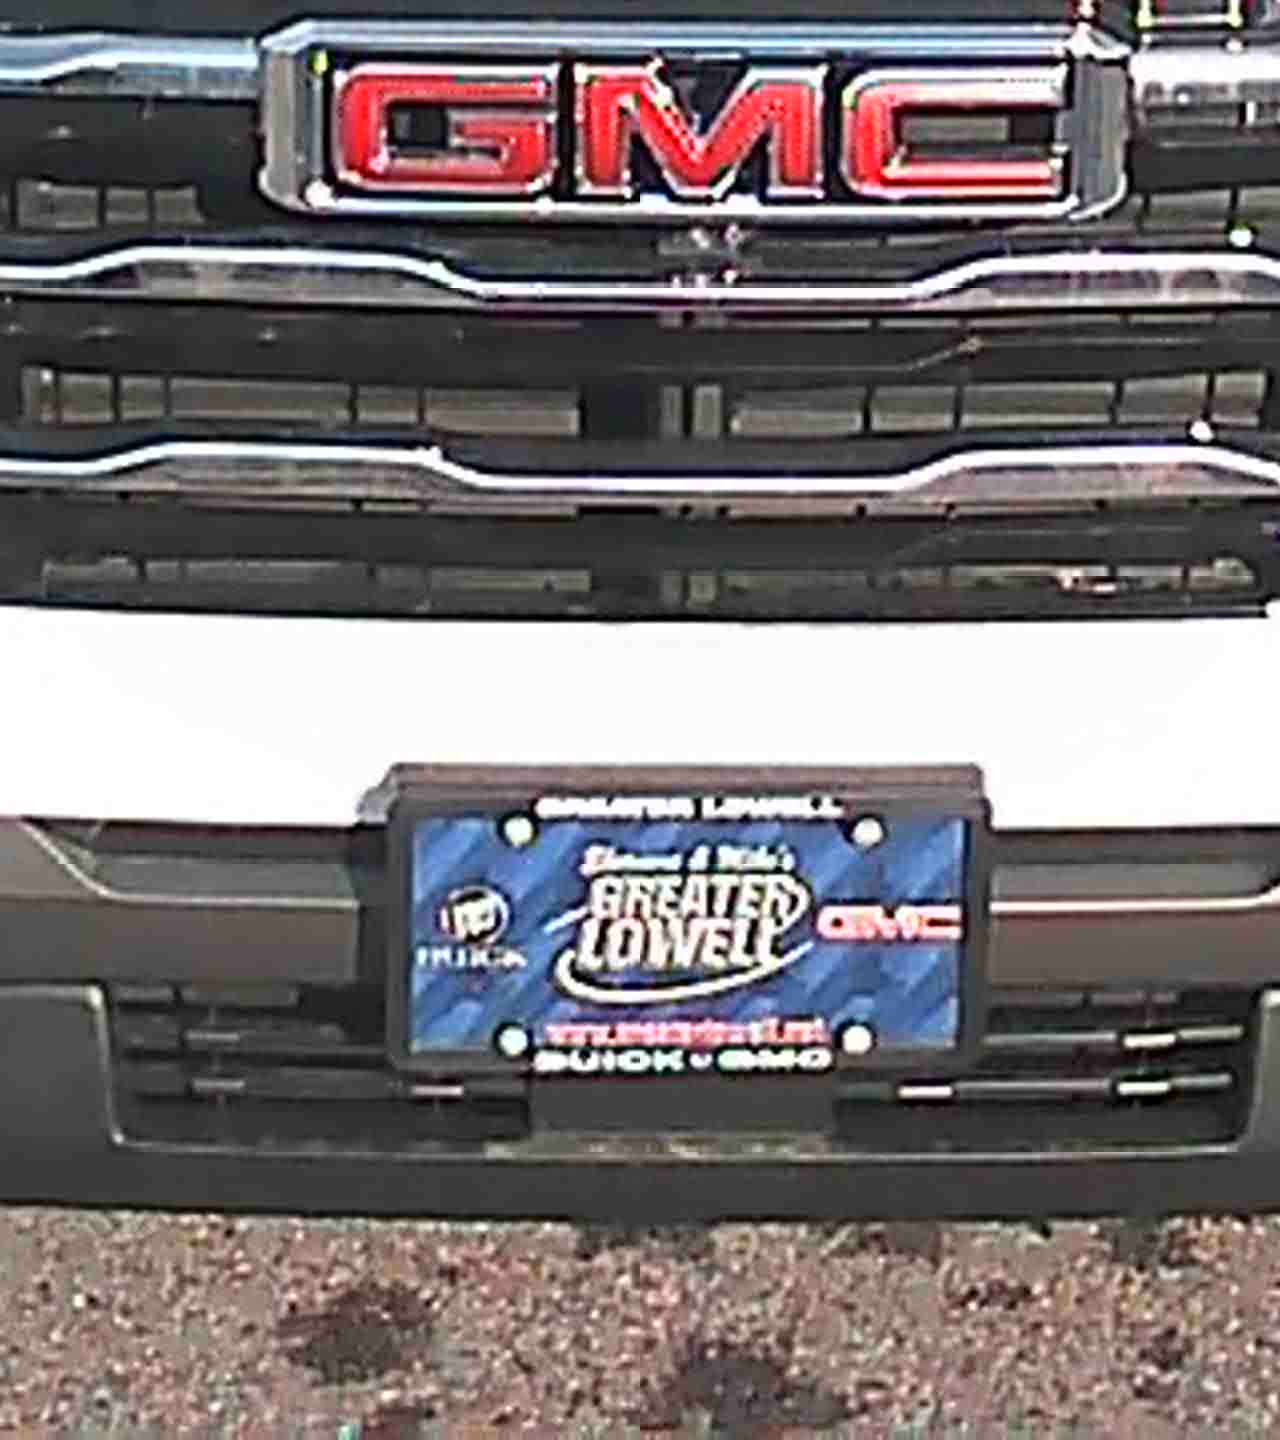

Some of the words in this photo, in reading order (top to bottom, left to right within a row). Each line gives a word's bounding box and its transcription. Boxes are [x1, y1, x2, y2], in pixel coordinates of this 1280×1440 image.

[333, 57, 1070, 202] GMC
[588, 874, 792, 920] GREATER
[576, 916, 784, 971] LOWELL
[817, 905, 962, 940] GMC
